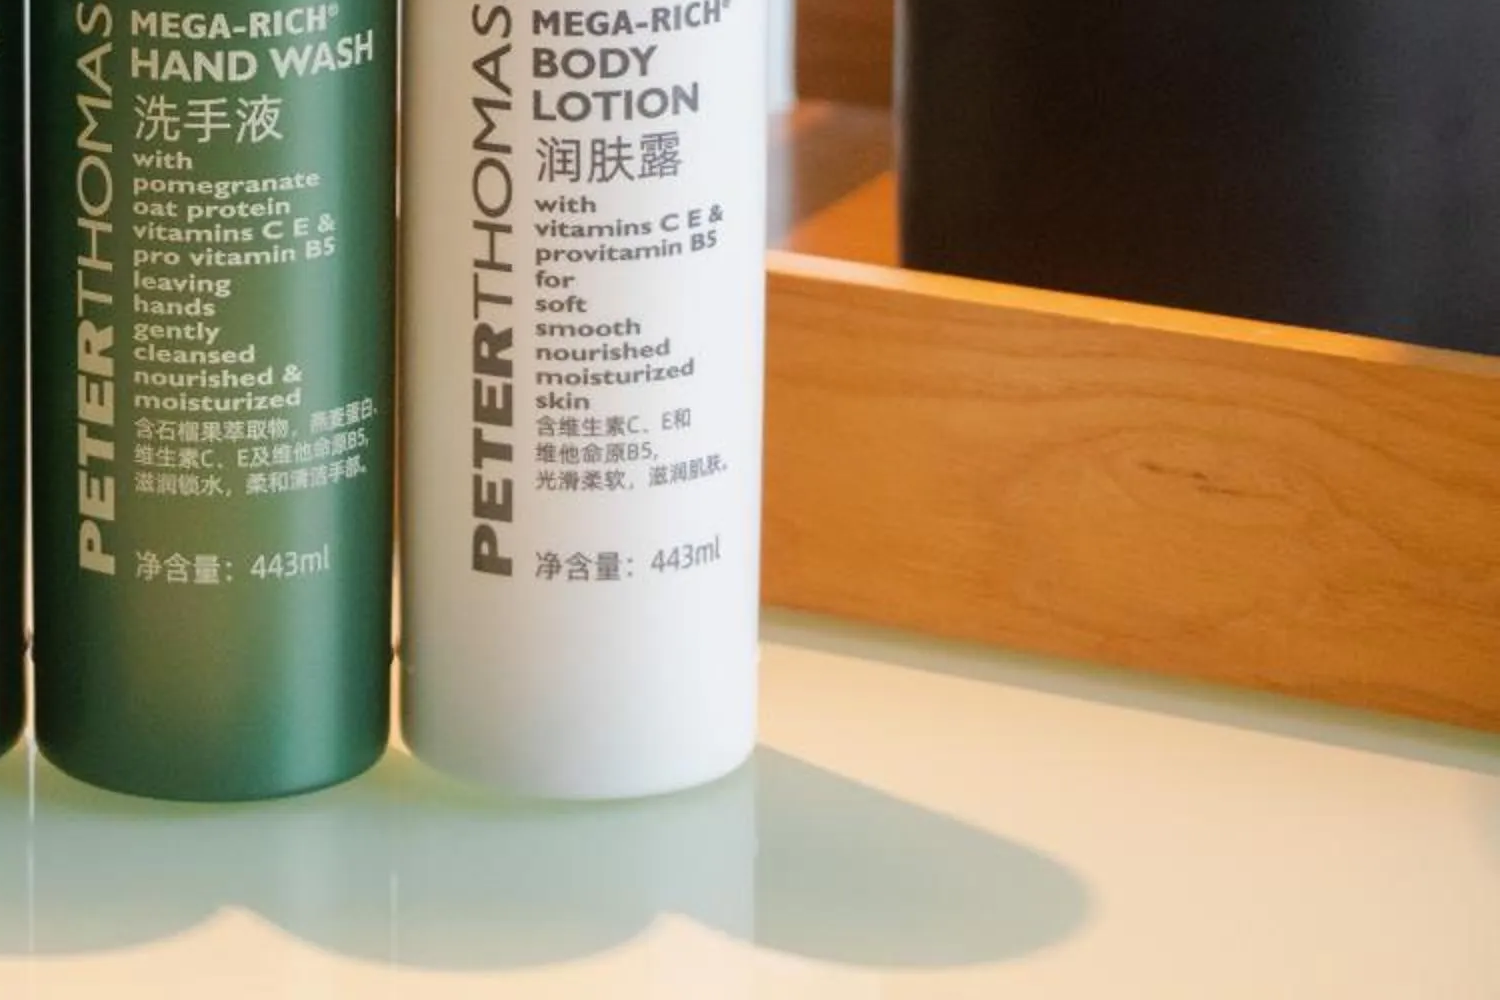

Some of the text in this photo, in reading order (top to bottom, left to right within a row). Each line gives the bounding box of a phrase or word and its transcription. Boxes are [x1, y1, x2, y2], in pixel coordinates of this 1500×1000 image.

[131, 28, 374, 83] HAND WASH
[532, 44, 658, 80] BODY
[532, 81, 699, 123] LOTION
[134, 93, 283, 143] 洗手液
[132, 149, 193, 170] with
[535, 131, 682, 184] 润肤露
[133, 173, 320, 201] pomegranate
[132, 197, 291, 224] oat protein
[534, 195, 597, 214] with
[132, 213, 335, 243] vitamins C E &
[533, 204, 723, 238] vitamins C E &
[133, 235, 336, 267] pro vitamin B5
[535, 229, 717, 267] provitamin B5
[133, 269, 232, 298] leaving
[535, 269, 576, 289] for
[133, 293, 216, 318] hands
[534, 295, 587, 313] soft
[132, 321, 221, 346] gently
[535, 317, 641, 338] smooth
[133, 343, 255, 365] cleansed
[535, 337, 671, 362] nourished
[133, 363, 303, 389] nourished &
[535, 357, 695, 386] moisturized
[134, 387, 301, 412] moisturized
[535, 391, 590, 411] skin
